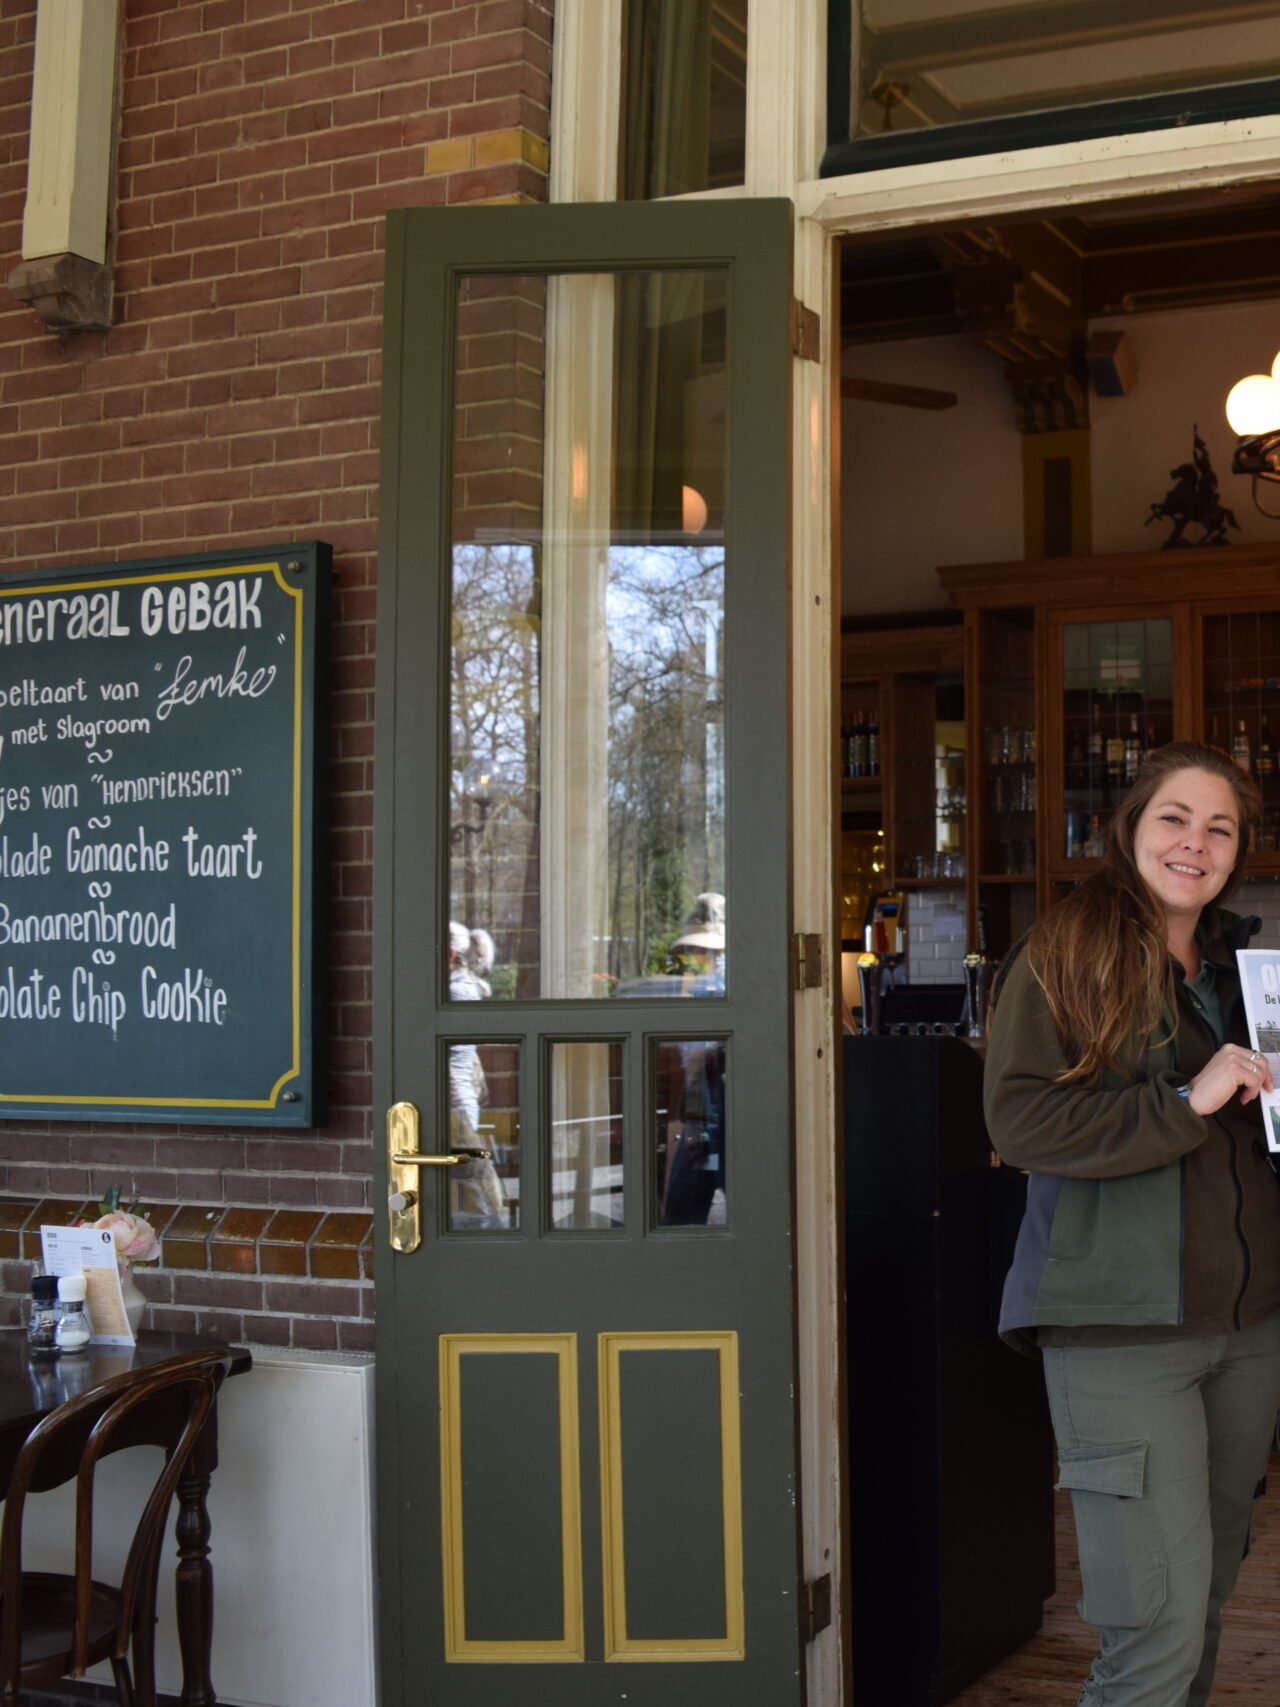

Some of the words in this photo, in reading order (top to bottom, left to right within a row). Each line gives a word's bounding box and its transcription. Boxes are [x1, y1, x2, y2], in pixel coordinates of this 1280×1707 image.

[99, 681, 139, 701] van
[11, 718, 48, 745] met
[41, 783, 79, 809] van
[0, 831, 53, 878] lade
[66, 825, 170, 874] Ganache
[181, 825, 263, 880] taart
[0, 901, 176, 950] Bananenbrood
[71, 966, 127, 1034] Chip
[1264, 993, 1277, 1005] De
